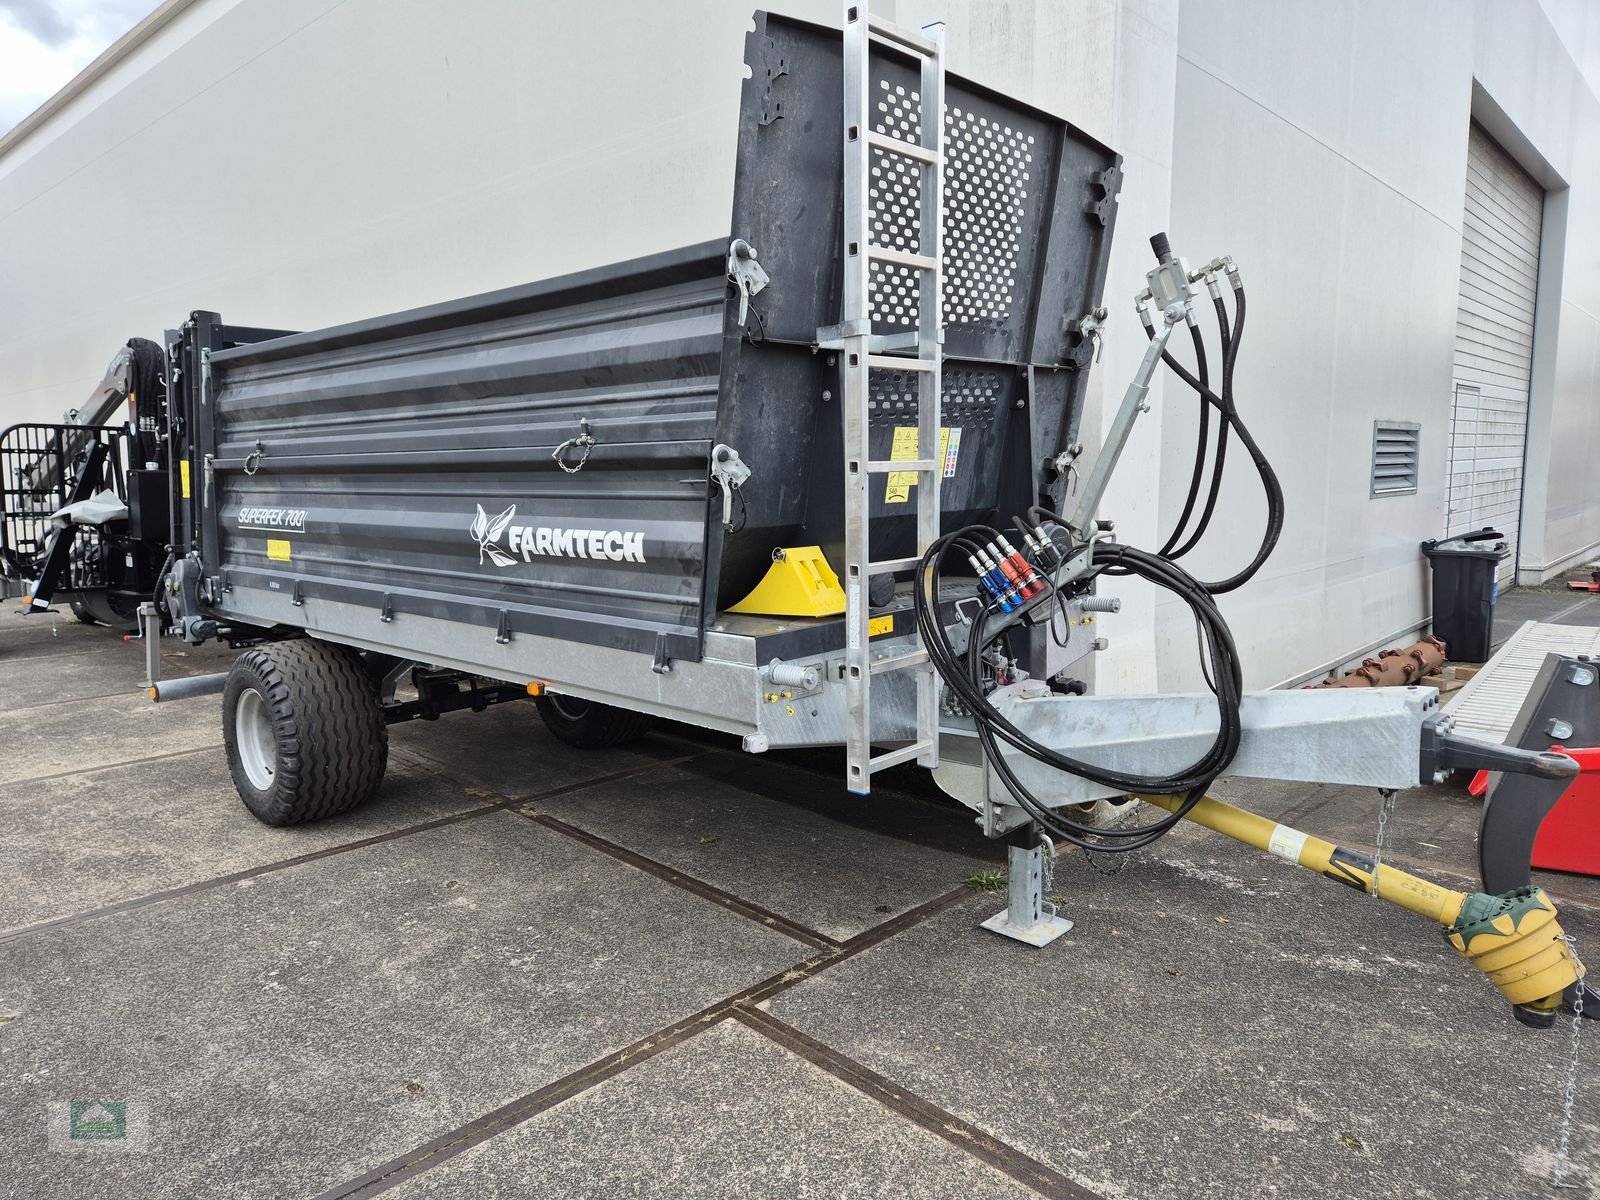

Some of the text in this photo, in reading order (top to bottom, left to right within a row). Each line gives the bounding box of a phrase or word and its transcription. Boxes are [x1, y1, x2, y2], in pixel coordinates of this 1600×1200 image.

[238, 507, 306, 527] SUPERFEX 700
[508, 525, 647, 563] FARMTECH
